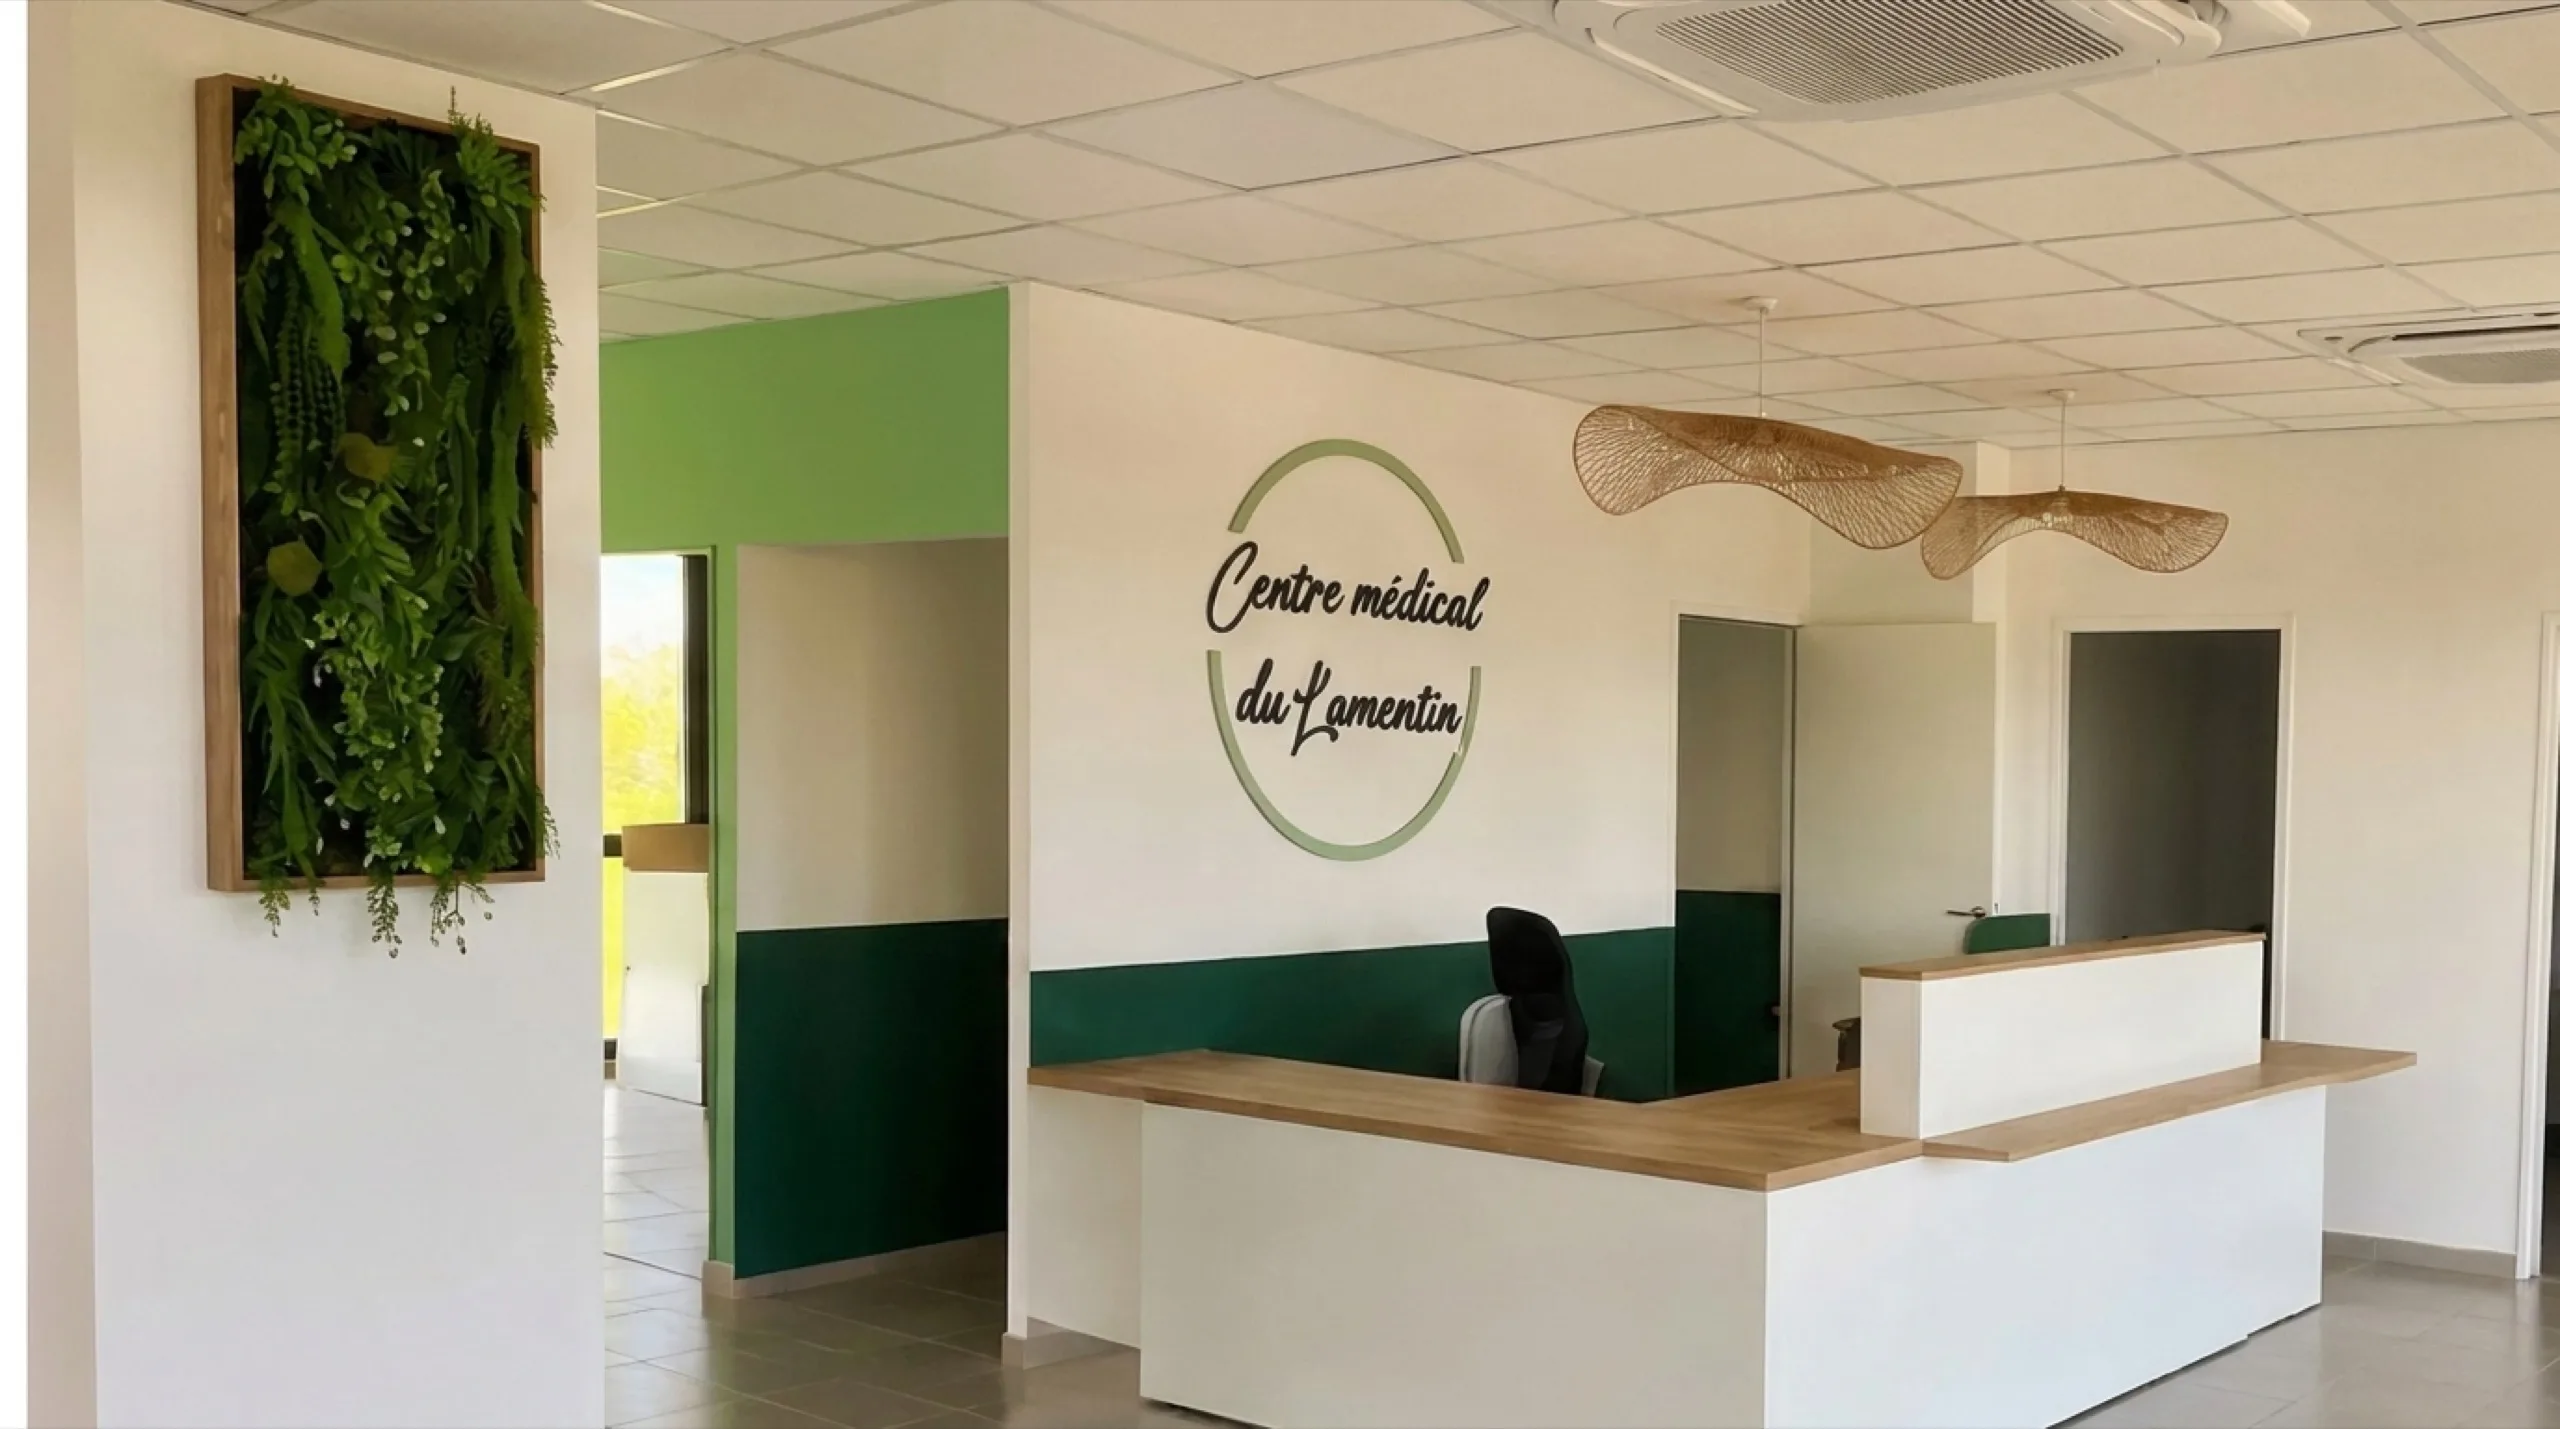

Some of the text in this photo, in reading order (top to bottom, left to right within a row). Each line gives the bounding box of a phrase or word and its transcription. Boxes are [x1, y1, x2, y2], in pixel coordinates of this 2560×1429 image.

[1207, 541, 1491, 634] Centre médical
[1236, 658, 1462, 757] du Lamentin
